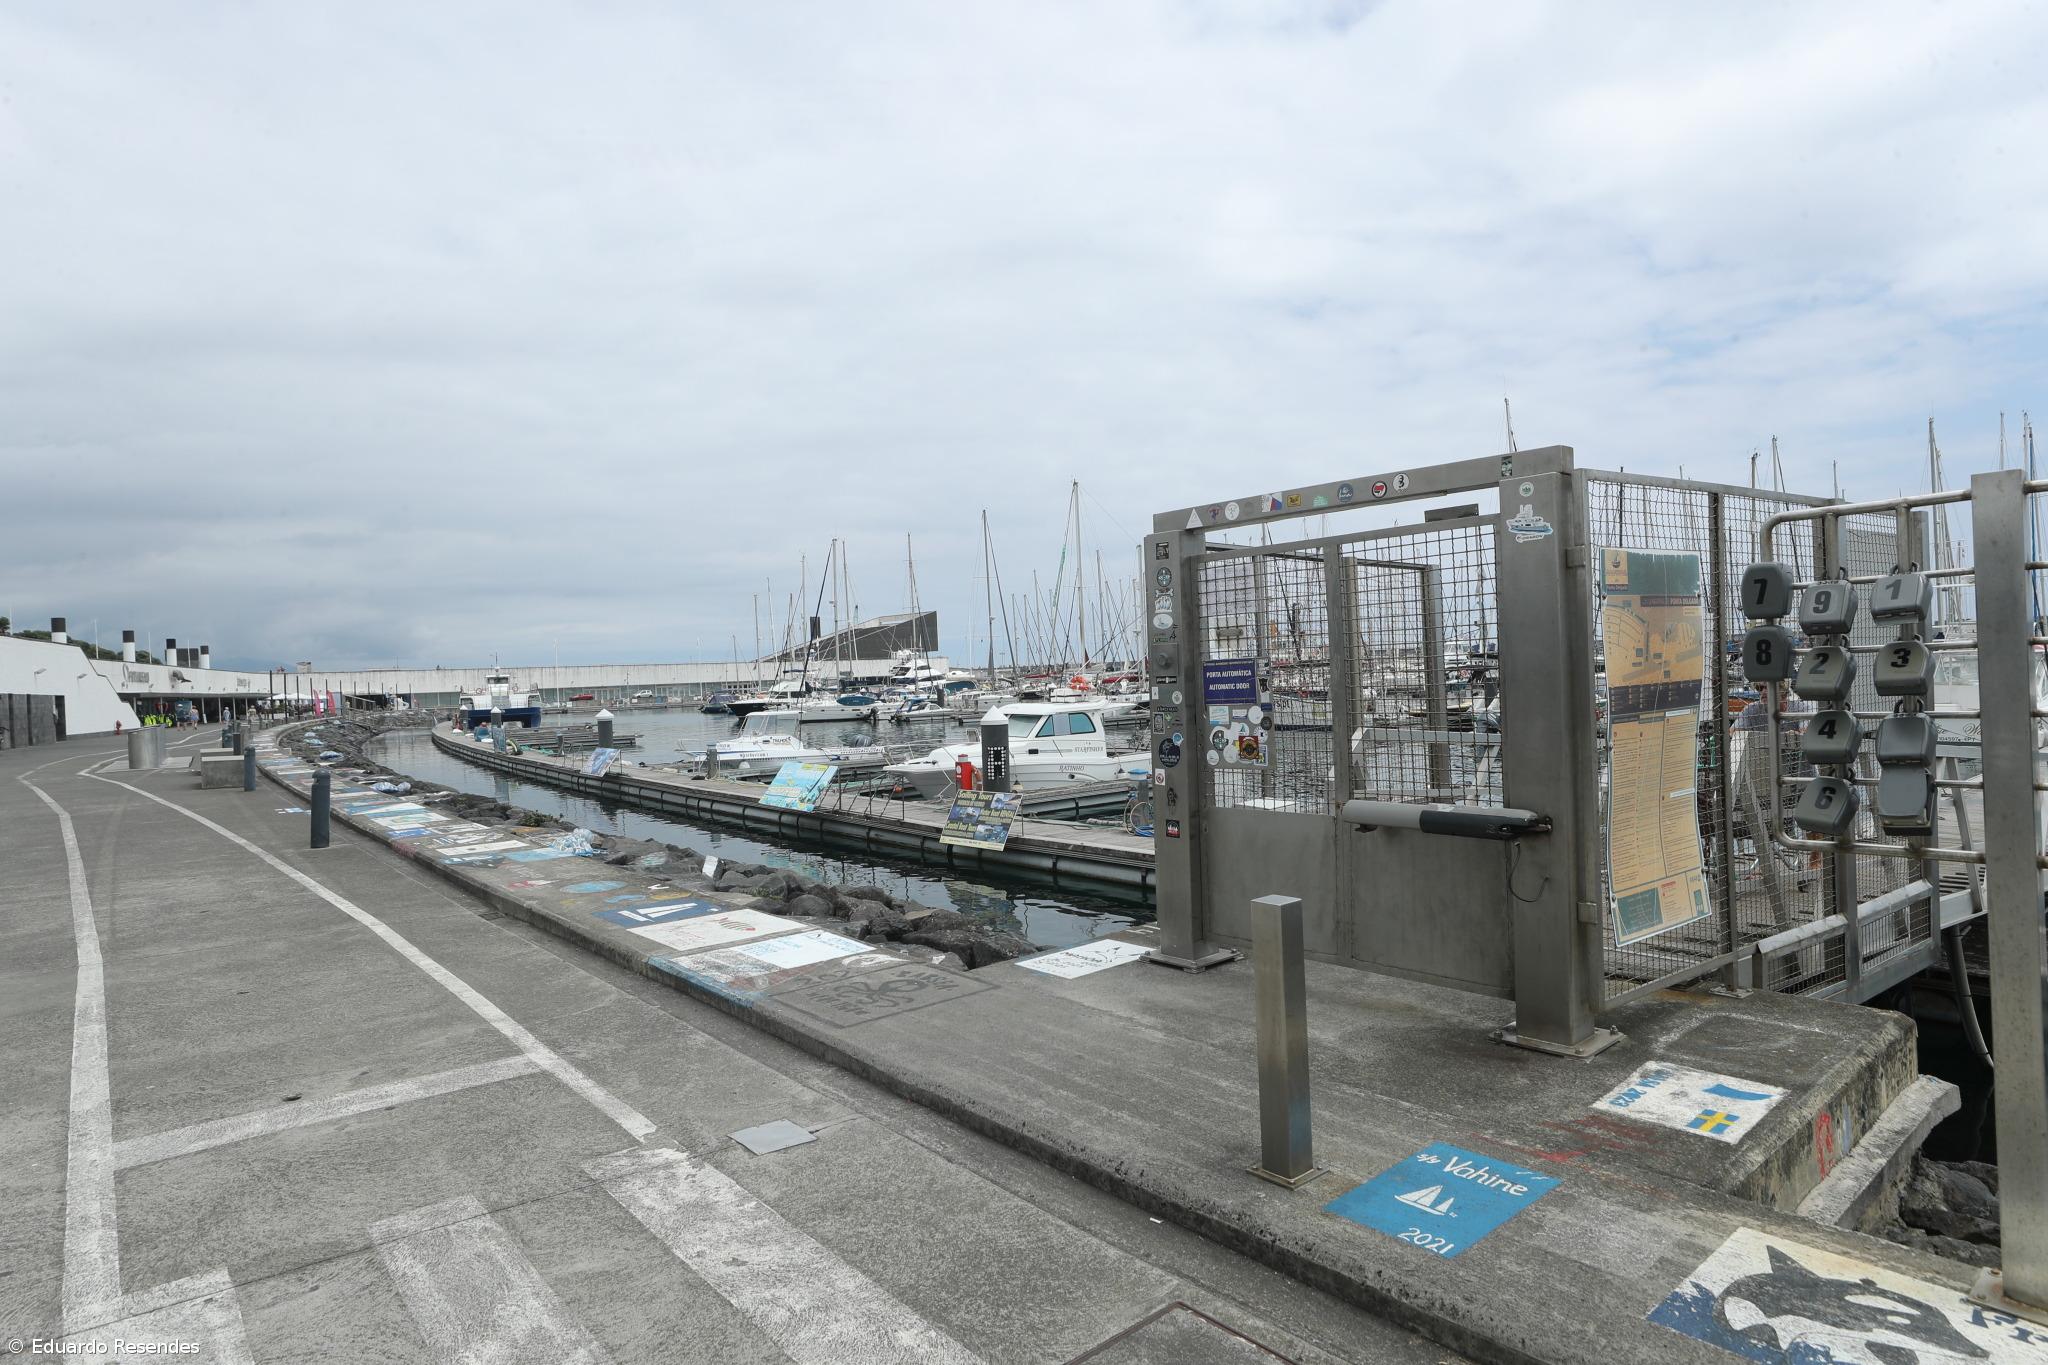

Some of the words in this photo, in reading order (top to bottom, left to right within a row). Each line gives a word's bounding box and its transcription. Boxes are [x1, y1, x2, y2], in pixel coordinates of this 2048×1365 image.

[1753, 578, 1768, 605] 7
[1813, 590, 1831, 614] 9
[1885, 579, 1902, 601] 1
[1756, 639, 1772, 666] 8
[1809, 652, 1830, 675] 2
[1891, 647, 1911, 668] 3
[1818, 719, 1837, 740] 4
[1814, 786, 1837, 810] 6
[1416, 1153, 1442, 1165] s/y
[1442, 1155, 1529, 1197] Vahine
[1397, 1227, 1456, 1255] 2021
